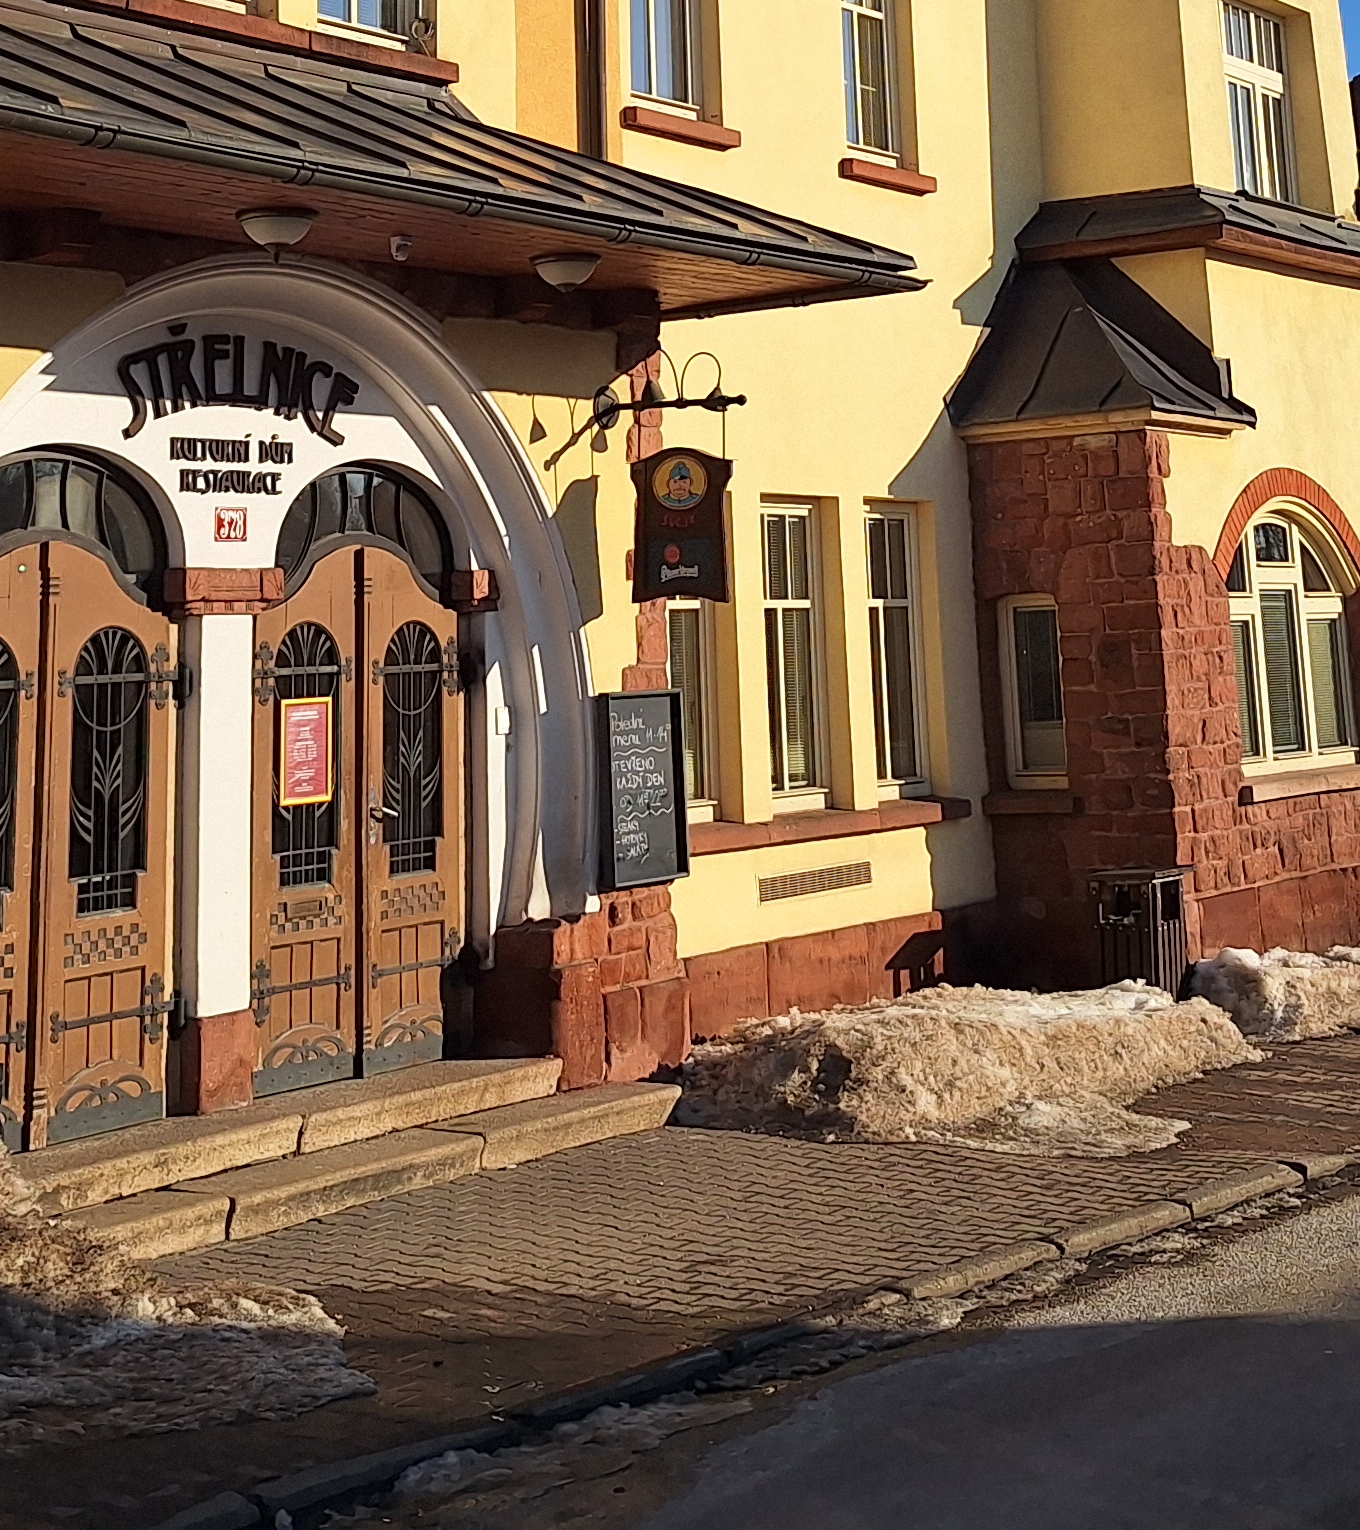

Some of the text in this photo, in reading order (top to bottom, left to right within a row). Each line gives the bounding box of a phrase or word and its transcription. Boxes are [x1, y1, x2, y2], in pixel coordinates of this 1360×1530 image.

[116, 323, 359, 447] STŘELNICE
[170, 433, 293, 465] KULTURNÍ DŮM
[179, 469, 282, 495] RESTAURACE
[219, 510, 244, 539] 378
[645, 769, 665, 787] DEN
